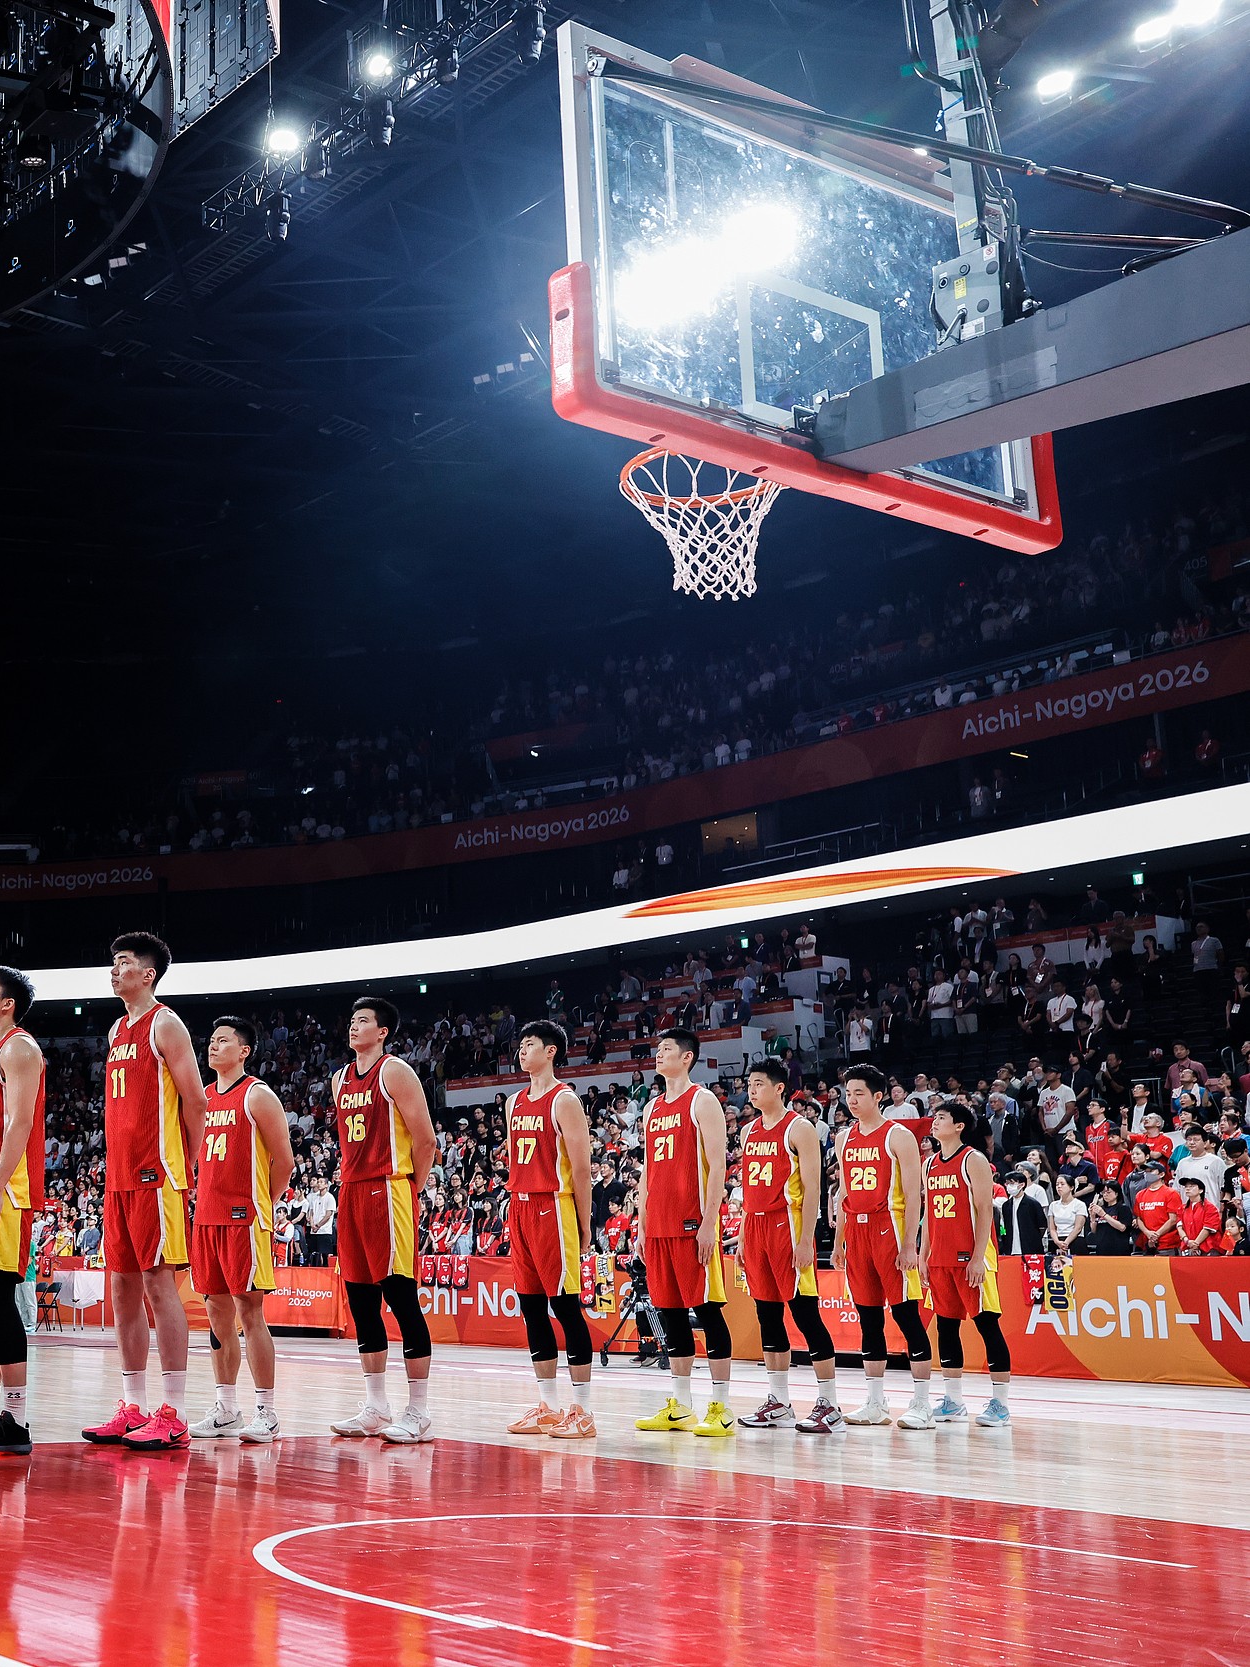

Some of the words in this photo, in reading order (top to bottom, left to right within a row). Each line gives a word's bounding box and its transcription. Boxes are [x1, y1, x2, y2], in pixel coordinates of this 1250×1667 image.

[962, 680, 1134, 741] Aichi-Nagoya
[1138, 660, 1210, 698] 2026
[454, 816, 586, 850] Aichi-Nagoya
[587, 804, 630, 830] 2026
[108, 865, 154, 883] 2026
[108, 1043, 137, 1063] CHINA
[110, 1067, 125, 1099] 11
[340, 1090, 372, 1110] CHINA
[205, 1109, 236, 1128] CHINA
[344, 1113, 366, 1143] 16
[511, 1116, 544, 1132] CHINA
[649, 1113, 681, 1133] CHINA
[205, 1133, 227, 1162] 14
[516, 1137, 536, 1165] 17
[654, 1134, 674, 1162] 21
[745, 1141, 778, 1156] CHINA
[845, 1146, 881, 1162] CHINA
[748, 1161, 773, 1187] 24
[850, 1167, 877, 1191] 26
[928, 1174, 959, 1190] CHINA
[933, 1194, 956, 1219] 32
[268, 1287, 332, 1300] Aichi-Nagoya
[288, 1298, 312, 1307] 2026
